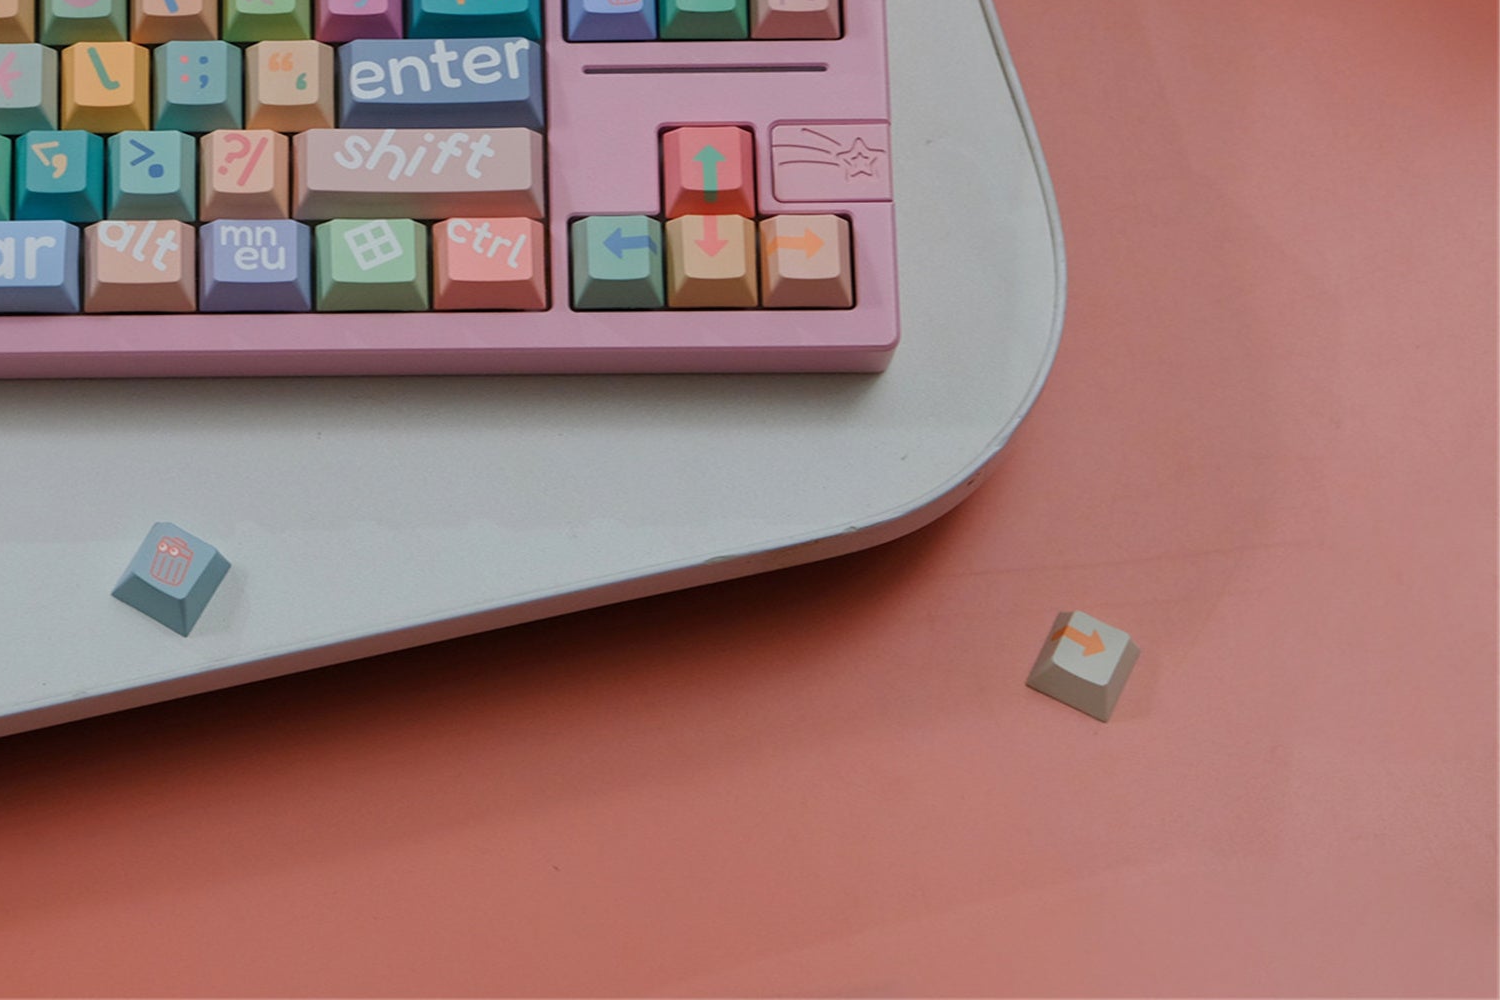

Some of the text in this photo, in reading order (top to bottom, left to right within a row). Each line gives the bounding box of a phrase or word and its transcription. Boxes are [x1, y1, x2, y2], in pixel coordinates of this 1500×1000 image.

[87, 46, 120, 91] l
[350, 37, 530, 100] enter
[333, 129, 495, 181] shift
[99, 221, 180, 271] alt
[220, 224, 278, 247] mn
[234, 245, 286, 271] eu
[446, 219, 527, 269] ctrl
